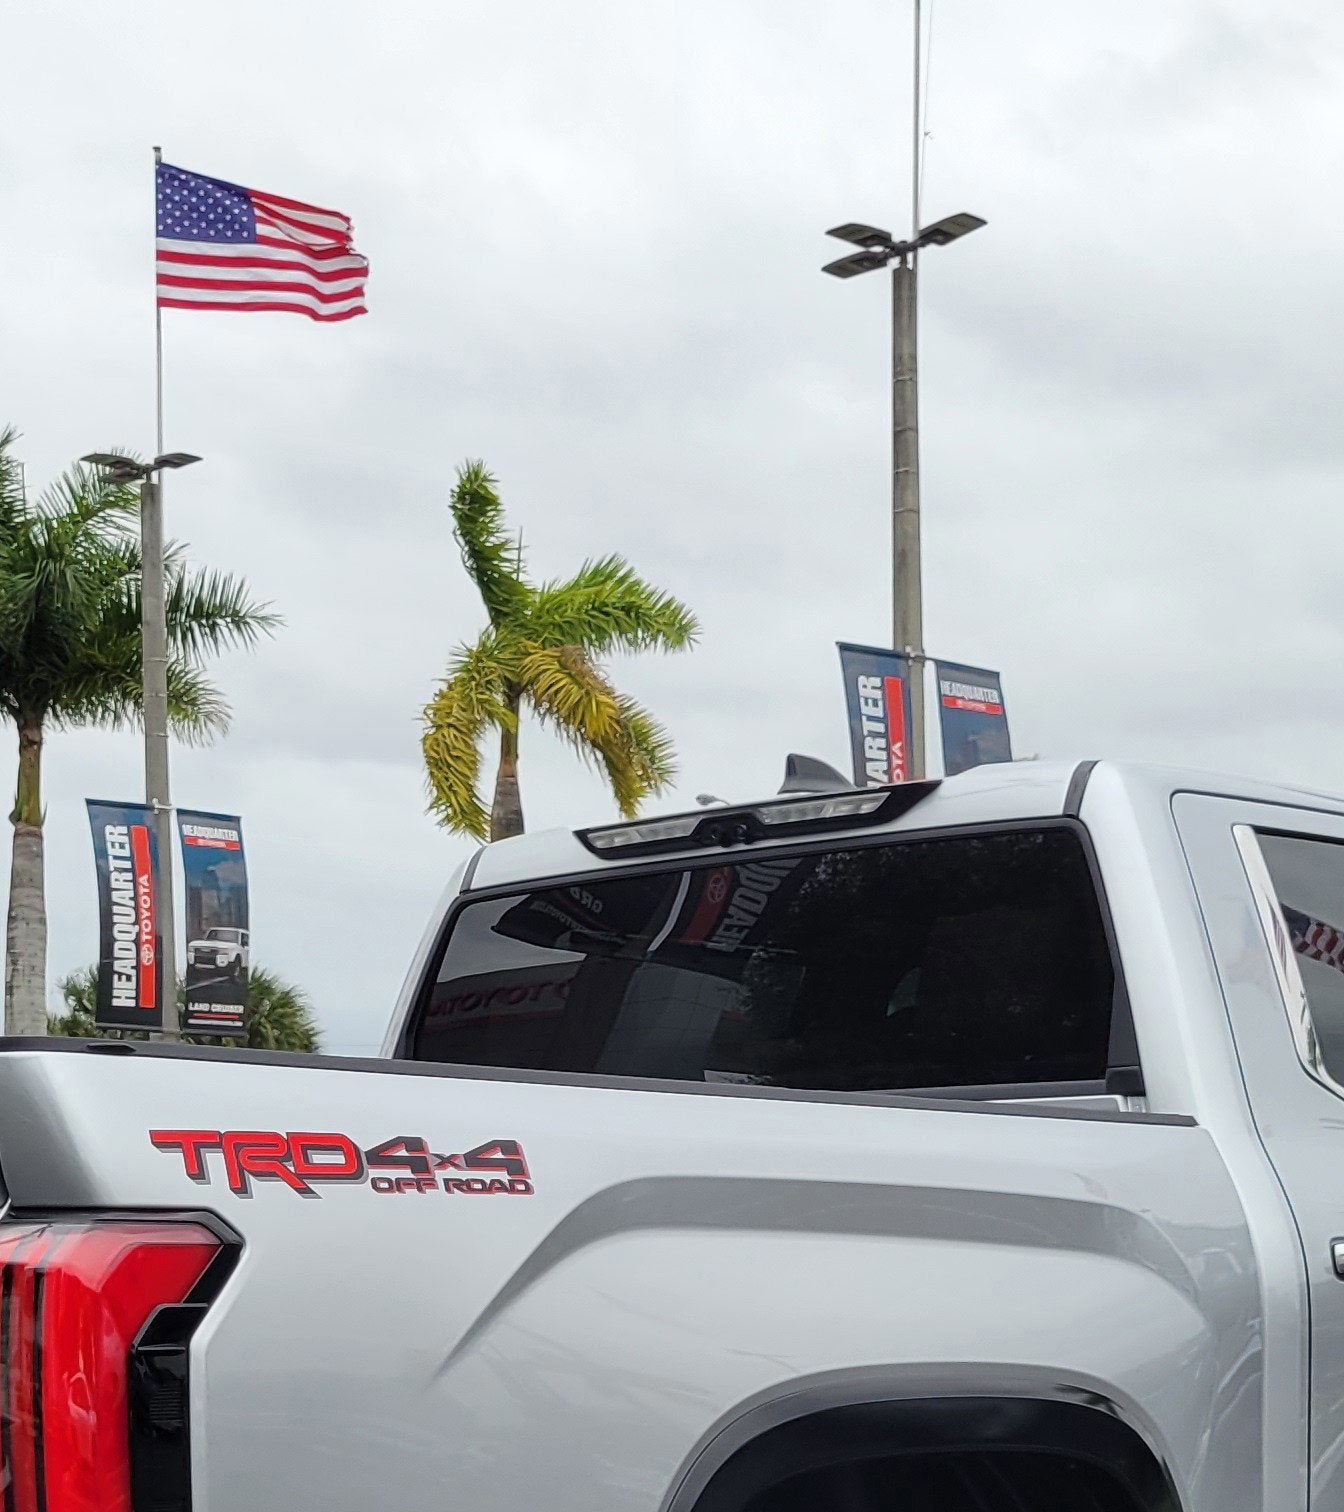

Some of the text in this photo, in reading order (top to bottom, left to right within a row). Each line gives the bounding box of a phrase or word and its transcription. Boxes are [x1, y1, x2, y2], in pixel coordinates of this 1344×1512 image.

[858, 675, 890, 787] ARTER
[105, 825, 137, 1008] HEADQUARTER
[137, 874, 153, 943] TOYOTA
[149, 1129, 368, 1200] TRD
[370, 1177, 535, 1196] OFF ROAD
